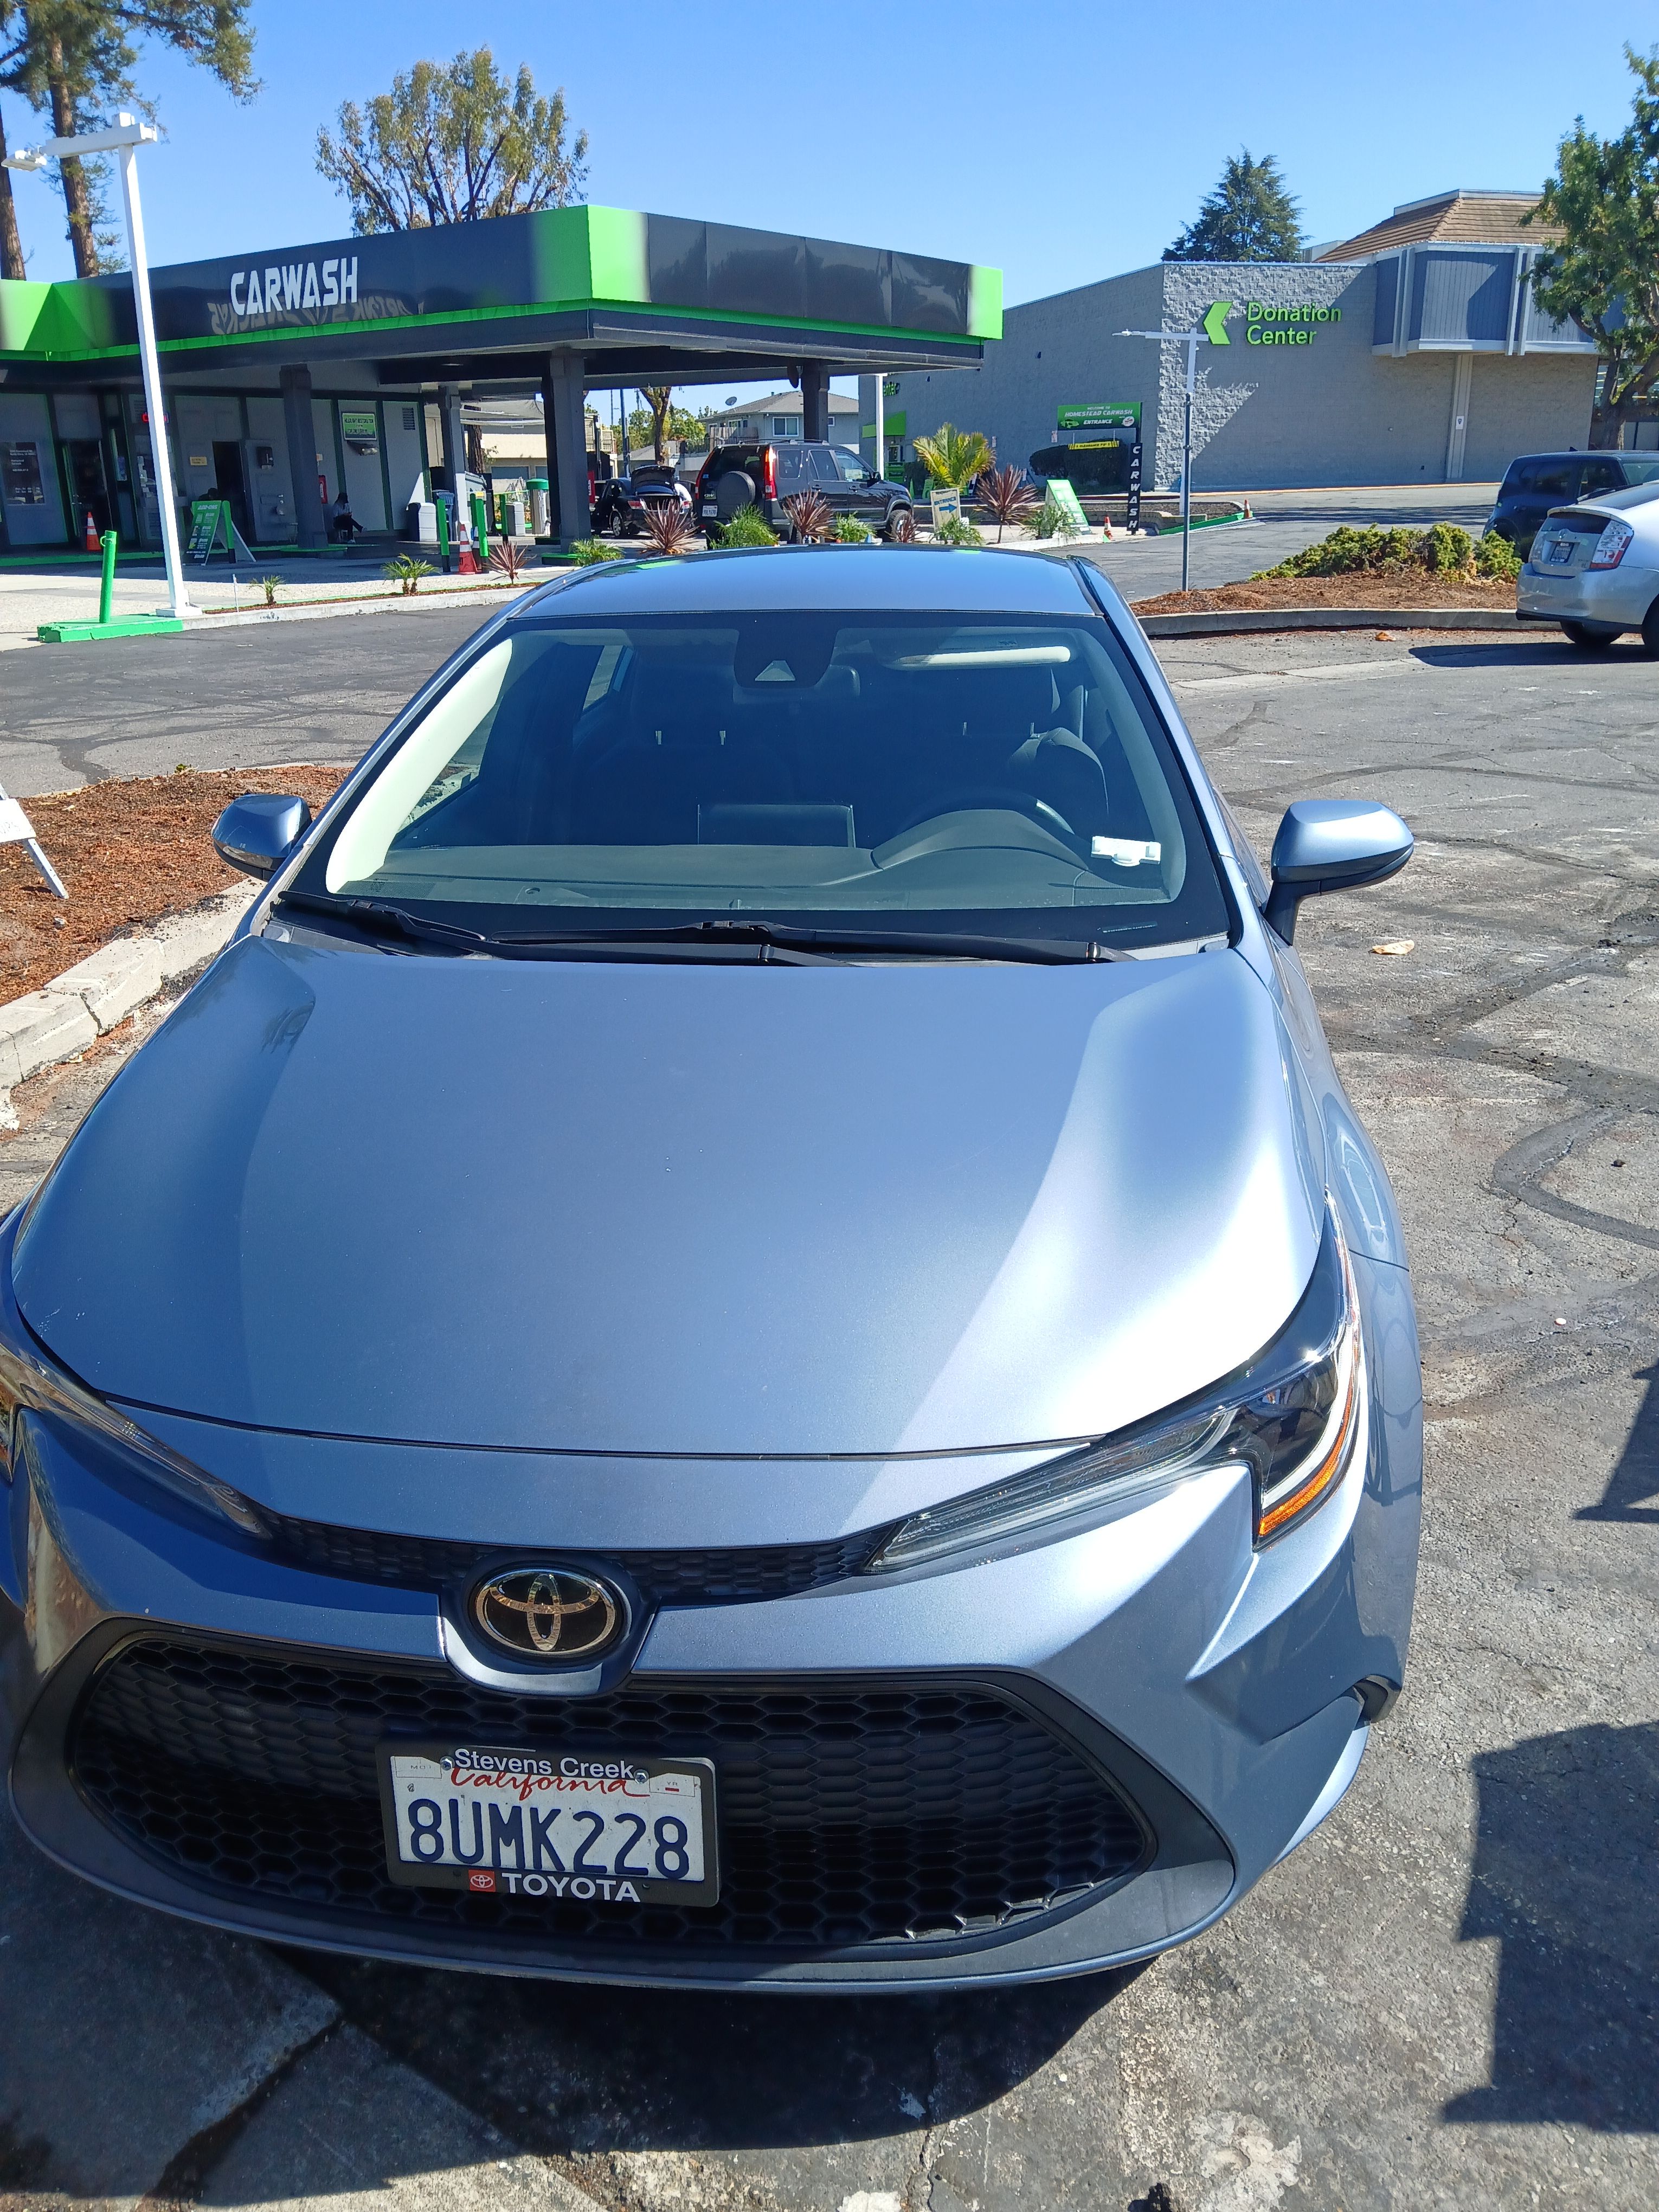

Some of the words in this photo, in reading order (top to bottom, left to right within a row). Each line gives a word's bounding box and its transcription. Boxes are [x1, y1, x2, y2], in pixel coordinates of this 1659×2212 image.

[230, 256, 358, 316] CARWASH
[1246, 301, 1342, 321] Donation
[1246, 324, 1317, 345] Center
[1128, 446, 1141, 528] CARWASH
[454, 1748, 552, 1774] Stevens
[560, 1757, 634, 1779] Creek
[451, 1767, 651, 1801] California
[408, 1798, 690, 1879] 8UMK228
[501, 1873, 641, 1903] TOYOTA
